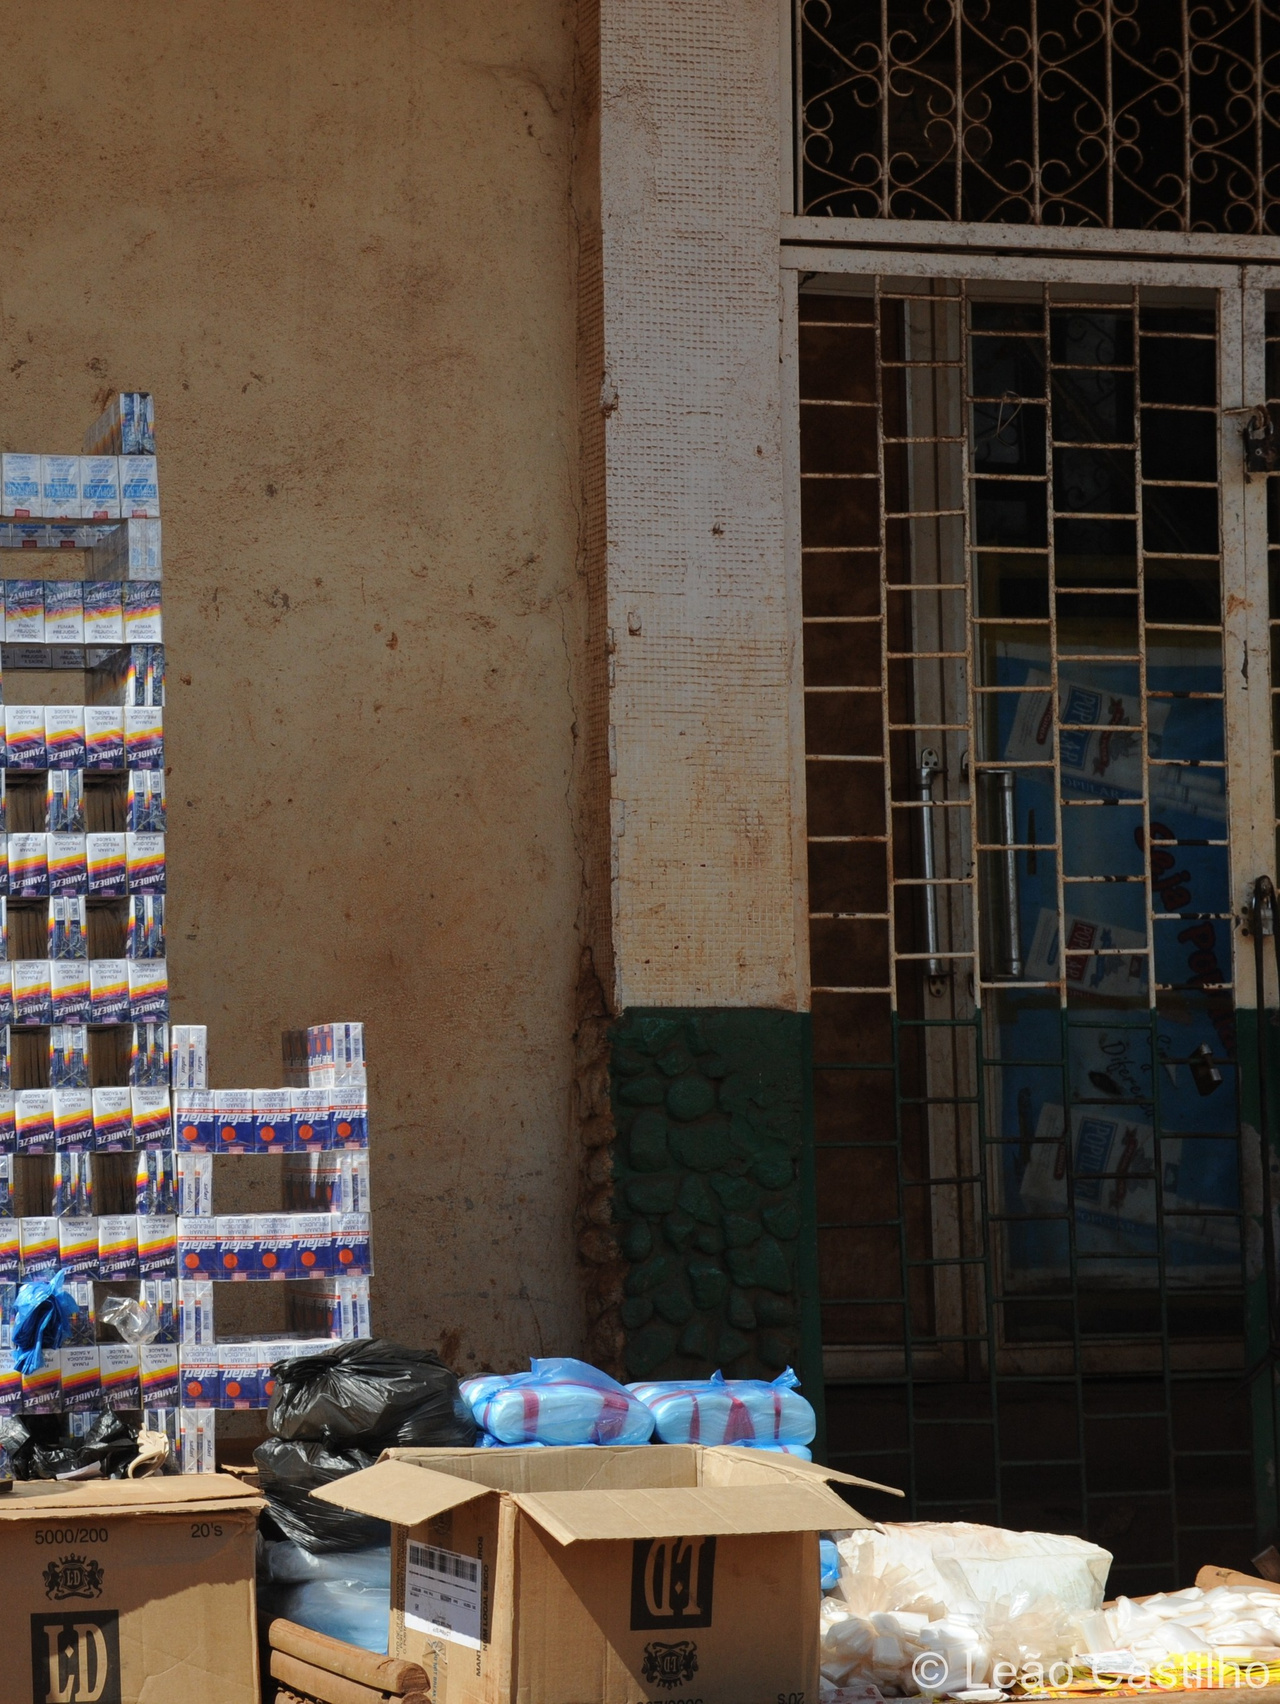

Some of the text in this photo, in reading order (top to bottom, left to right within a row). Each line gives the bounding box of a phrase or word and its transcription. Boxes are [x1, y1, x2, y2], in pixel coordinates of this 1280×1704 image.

[8, 587, 45, 601] ZAMBEZE
[47, 588, 84, 602] ZAMBEZE
[86, 589, 122, 601] ZAMBEZE
[125, 588, 160, 601] ZAMBEZE
[9, 746, 45, 762] ZAMBEZE
[48, 746, 84, 762] ZAMBEZE
[88, 747, 123, 762] ZAMBEZE
[127, 746, 162, 762] ZAMBEZE
[11, 874, 47, 889] ZAMBEZE
[50, 873, 87, 889] ZAMBEZE
[90, 874, 125, 889] ZAMBEZE
[130, 873, 165, 888] ZAMBEZE
[54, 1001, 90, 1017] ZAMBEZE
[93, 1001, 128, 1016] ZAMBEZE
[131, 1000, 165, 1016] ZAMBEZE
[180, 1114, 214, 1125] safari
[219, 1114, 252, 1126] safari
[257, 1114, 291, 1125] safari
[296, 1112, 329, 1124] safari
[334, 1110, 367, 1122] safari
[19, 1130, 54, 1146] ZAMBEZE
[56, 1130, 92, 1146] ZAMBEZE
[97, 1129, 132, 1145] ZAMBEZE
[136, 1127, 170, 1144] ZAMBEZE
[182, 1241, 216, 1252] safari
[221, 1241, 254, 1252] safari
[260, 1240, 293, 1252] safari
[298, 1238, 332, 1250] safari
[336, 1236, 368, 1248] safari
[100, 1258, 136, 1274] ZAMBEZE
[140, 1256, 175, 1272] ZAMBEZE
[184, 1368, 218, 1381] safari
[223, 1369, 257, 1381] safari
[25, 1390, 59, 1408] ZAMBEZE
[65, 1389, 100, 1405] ZAMBEZE
[104, 1387, 138, 1403] ZAMBEZE
[143, 1385, 178, 1403] ZAMBEZE
[34, 1528, 109, 1546] 5000/200
[190, 1523, 223, 1538] 20's
